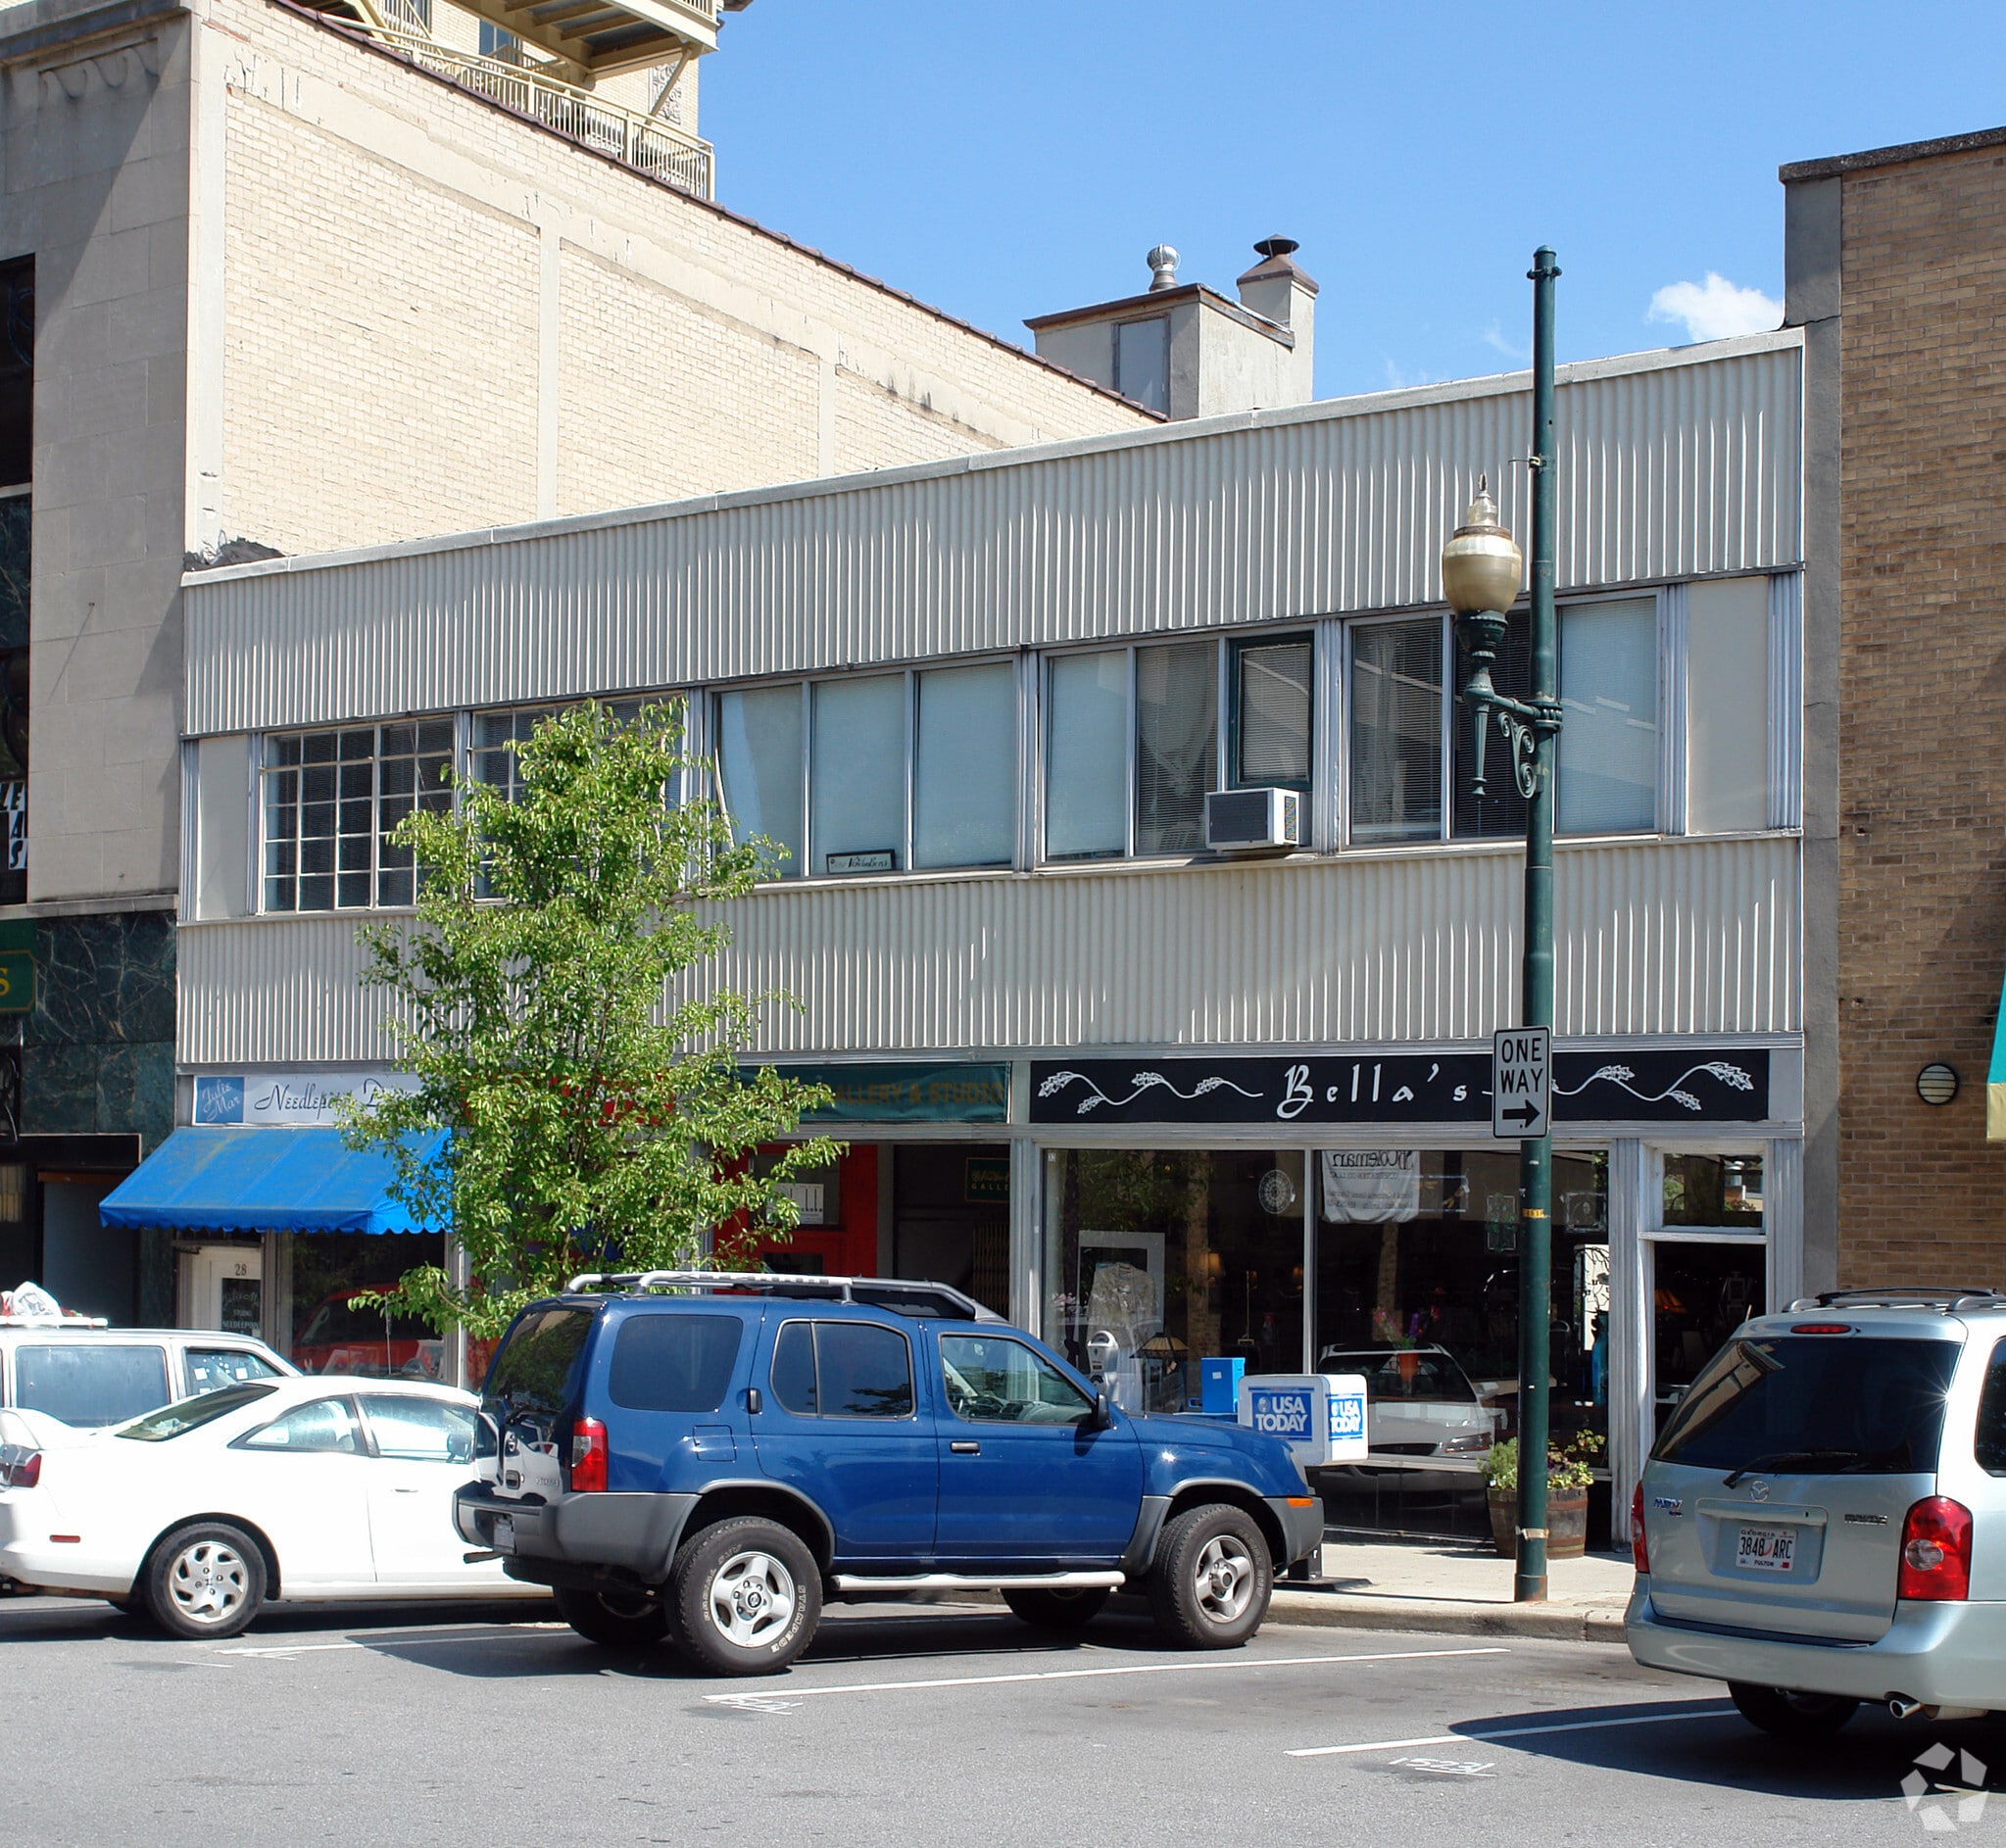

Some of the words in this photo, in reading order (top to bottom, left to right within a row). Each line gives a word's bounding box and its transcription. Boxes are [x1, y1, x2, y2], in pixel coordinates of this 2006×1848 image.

[1501, 1037, 1543, 1064] ONE
[1500, 1067, 1543, 1094] WAY
[831, 1082, 903, 1104] ALLERY
[929, 1082, 1003, 1103] STUDIO
[1276, 1063, 1468, 1119] Bella's
[234, 1263, 247, 1276] 28
[1273, 1396, 1306, 1414] USA
[1339, 1400, 1360, 1416] USA
[1255, 1414, 1308, 1432] TODAY
[1331, 1416, 1362, 1433] TODAY
[1738, 1536, 1765, 1556] 3848
[1772, 1538, 1792, 1559] ARC
